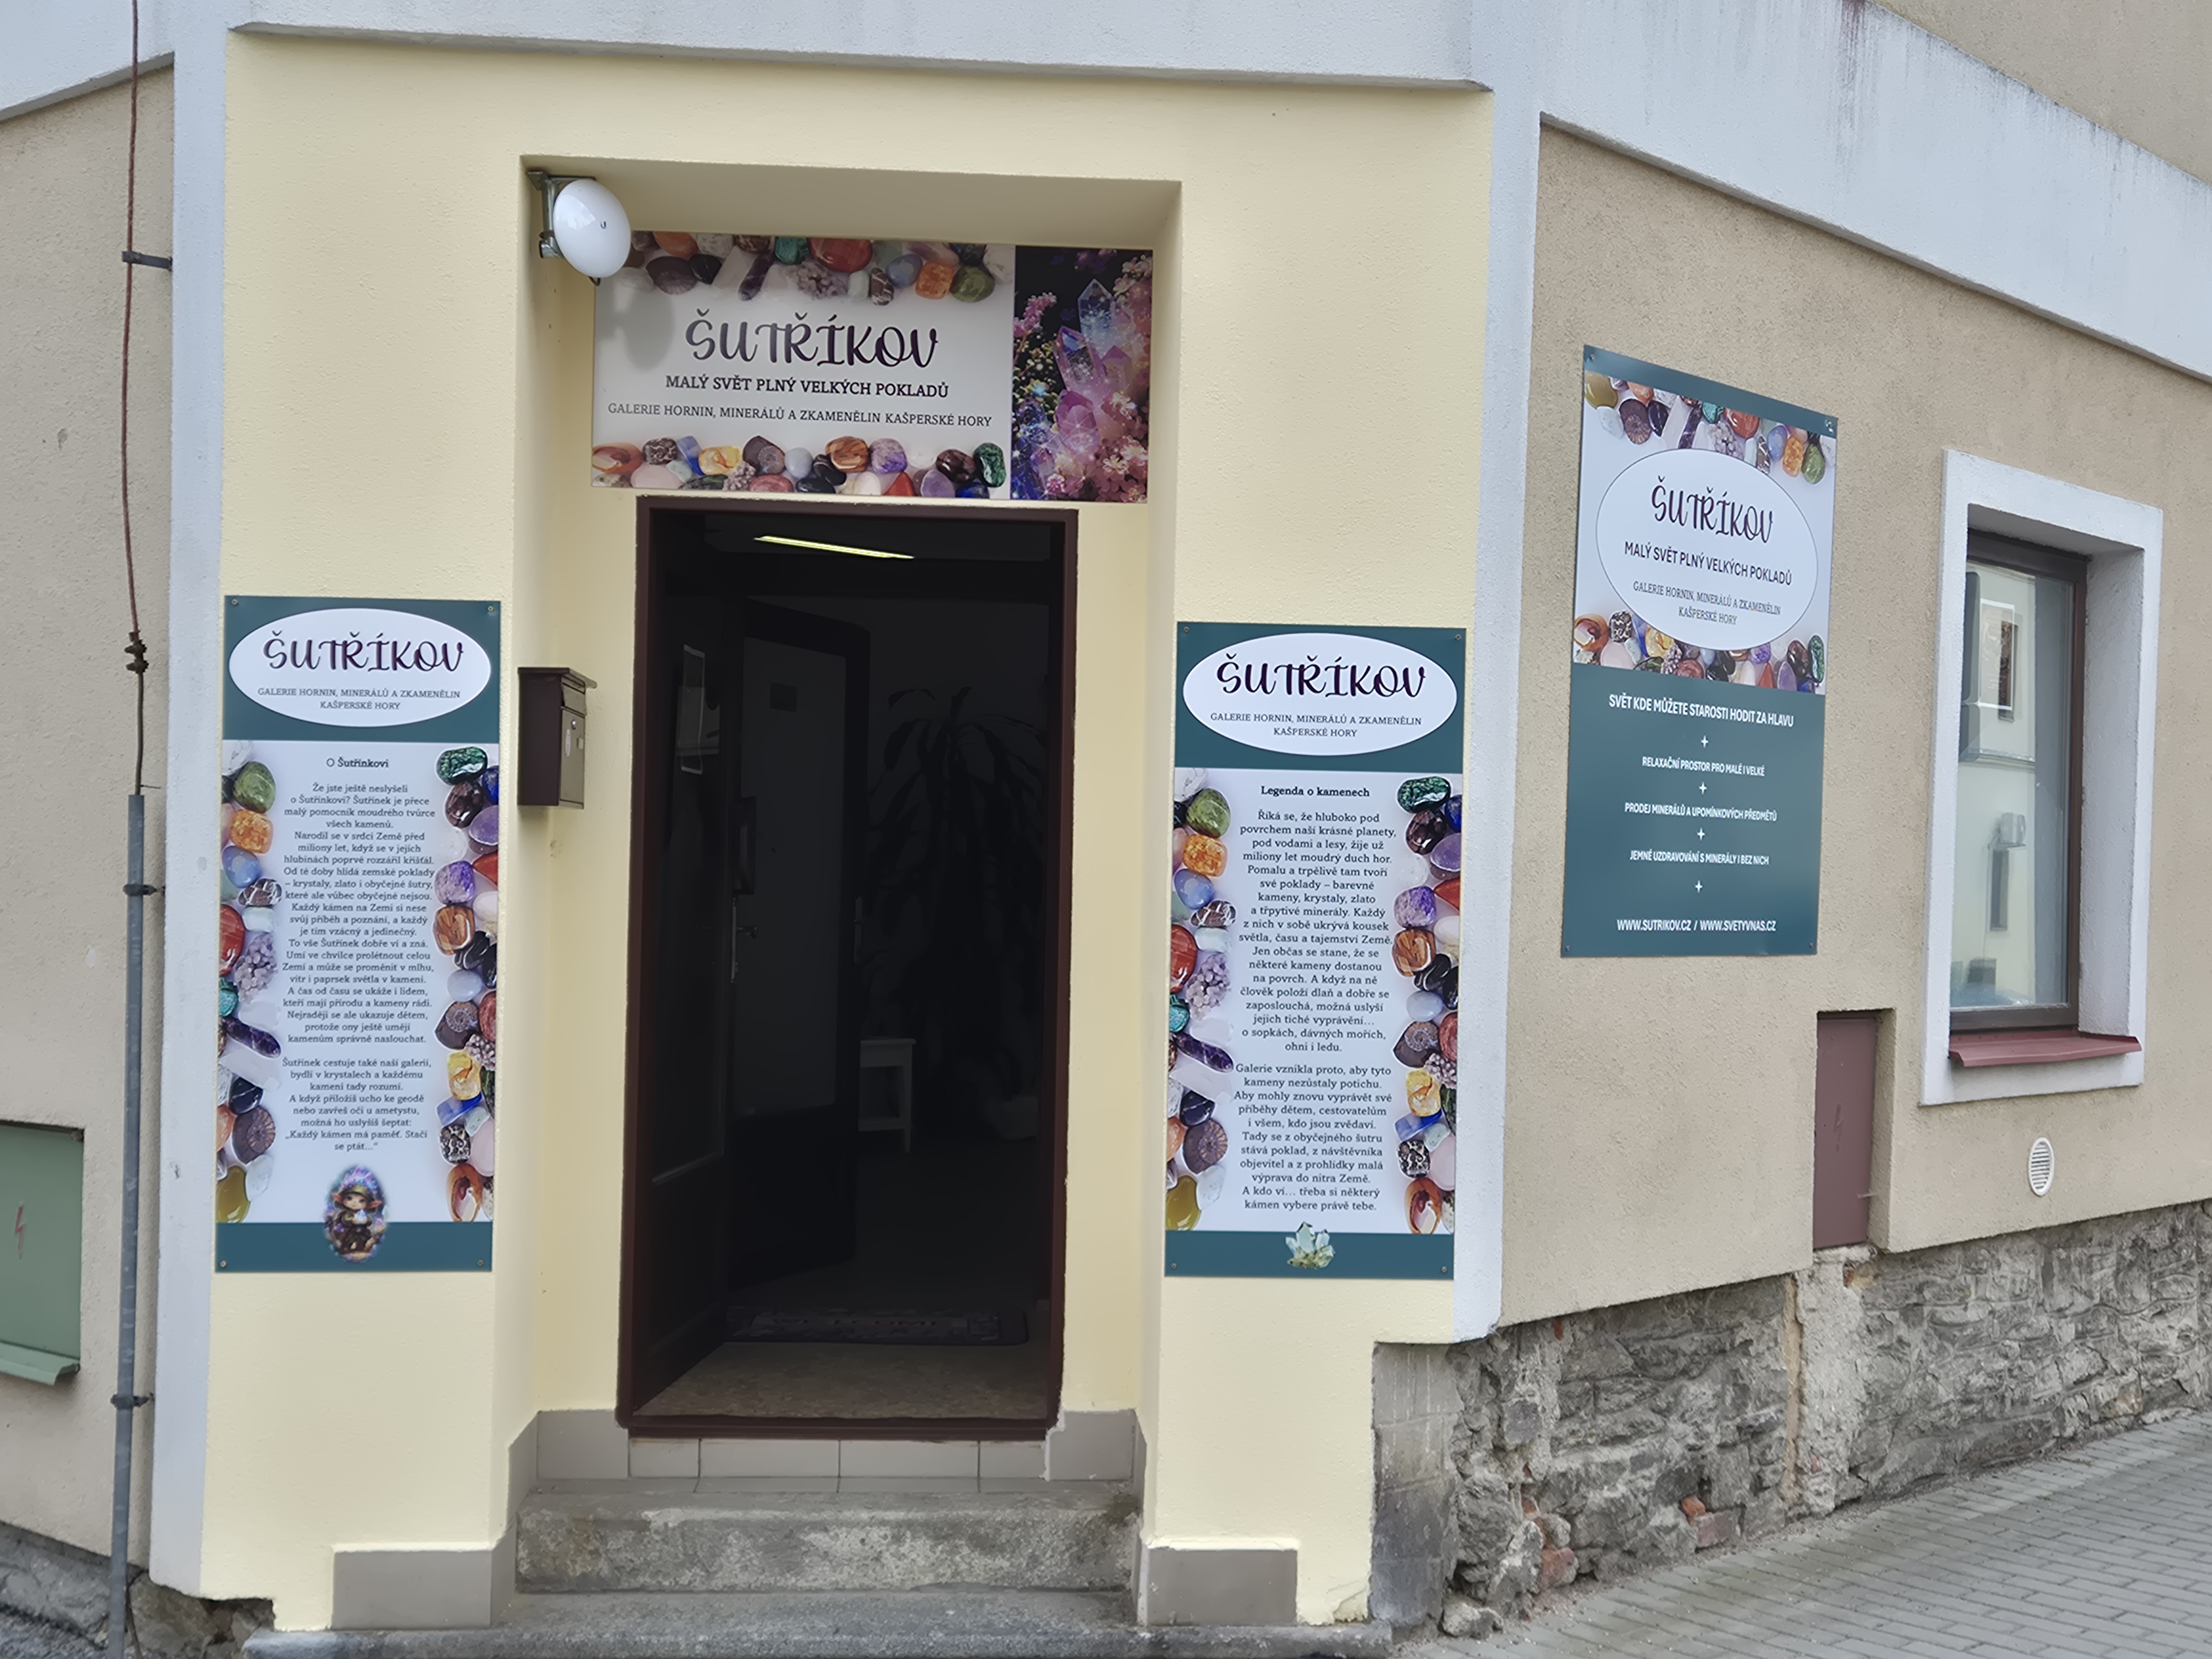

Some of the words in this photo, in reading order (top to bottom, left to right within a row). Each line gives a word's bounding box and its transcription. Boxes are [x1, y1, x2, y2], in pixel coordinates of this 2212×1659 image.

[686, 309, 938, 368] ŠUTŘÍKOV
[666, 373, 709, 388] MALÝ
[713, 374, 752, 390] SVĚT
[756, 377, 796, 392] PLNÝ
[800, 378, 870, 395] VELKÝCH
[875, 381, 948, 398] POKLADŮ
[608, 403, 660, 414] GALERIE
[664, 405, 716, 418] HORNIN,
[720, 406, 784, 419] MINERÁLŮ
[787, 410, 796, 420] A
[800, 410, 880, 422] ZKAMENĚLIN
[885, 411, 954, 425] KAŠPERSKÉ
[957, 415, 992, 426] HORY
[1652, 476, 1773, 543] ŠUTŘÍKOV
[1625, 541, 1652, 558] MALÝ
[1653, 546, 1678, 564] SVĚT
[1679, 551, 1704, 568] PLNÝ
[1706, 556, 1747, 577] VELKÝCH
[1750, 565, 1791, 585] POKLADŮ
[1633, 581, 1664, 595] GALERIE
[1665, 586, 1694, 602] HORNIN,
[1696, 591, 1731, 607] MINERÁLŮ
[1733, 598, 1738, 608] A
[1739, 599, 1780, 614] ZKAMENĚLIN
[1678, 606, 1717, 622] KAŠPERSKÉ
[1718, 613, 1737, 625] HORY
[263, 630, 463, 671] ŠUTŘÍKOV
[1217, 653, 1425, 697] ŠUTŘÍKOV
[299, 688, 338, 697] HORNIN,
[340, 687, 389, 697] MINERÁLŮ
[400, 689, 460, 698] ZKAMENĚLIN
[320, 700, 372, 709] KAŠPERSKÉ
[1609, 692, 1632, 708] SVĚT
[1633, 697, 1652, 711] KDE
[1653, 697, 1688, 716] MŮŽETE
[1689, 703, 1728, 719] STAROSTI
[1729, 708, 1755, 722] HODIT
[1756, 711, 1767, 724] ZA
[1767, 713, 1793, 727] HLAVU
[1210, 712, 1250, 721] GALERIE
[1254, 713, 1293, 723] HORNIN,
[1296, 713, 1347, 724] MINERÁLŮ
[1358, 716, 1421, 725] ZKAMENĚLIN
[1274, 726, 1327, 736] KAŠPERSKÉ
[1330, 728, 1357, 737] HORY
[326, 758, 335, 767] O
[337, 757, 388, 768] Šutřínkovi
[1642, 756, 1680, 769] RELAXAČNÍ
[1680, 759, 1710, 771] PROSTOR
[1710, 762, 1725, 773] PRO
[1725, 763, 1742, 774] MALÉ
[1745, 765, 1764, 776] VELKÉ
[312, 781, 324, 791] Že
[326, 784, 342, 794] jste
[343, 784, 366, 794] ještě
[368, 784, 408, 794] neslyšeli
[1261, 785, 1304, 797] Legenda
[1316, 786, 1370, 796] kamenech
[284, 807, 306, 817] malý
[309, 807, 354, 817] pomocník
[357, 808, 404, 816] moudrého
[406, 808, 435, 817] tvůrce
[1258, 808, 1280, 820] Říká
[1284, 813, 1297, 822] se,
[1300, 812, 1312, 821] že
[1315, 812, 1357, 822] hluboko
[1359, 813, 1379, 824] pod
[1624, 802, 1651, 813] PRODEJ
[1651, 803, 1686, 816] MINERÁLŮ
[1686, 806, 1691, 816] A
[1692, 806, 1743, 819] UPOMÍNKOVÝCH
[1744, 808, 1777, 821] PŘEDMĚTŮ
[326, 820, 352, 828] všech
[354, 820, 393, 828] kamenů.
[1240, 825, 1291, 835] povrchem
[1295, 826, 1315, 834] naší
[1318, 825, 1353, 835] krásné
[1356, 826, 1396, 838] planety,
[1243, 851, 1281, 863] miliony
[1285, 852, 1297, 861] let
[1300, 853, 1341, 864] moudrý
[1344, 853, 1369, 863] duch
[1373, 854, 1391, 863] hor.
[1629, 849, 1652, 860] JEMNÉ
[1652, 850, 1699, 862] UZDRAVOVÁNÍ
[1699, 853, 1704, 863] S
[1705, 852, 1736, 864] MINERÁLY
[1740, 854, 1752, 864] BEZ
[1752, 855, 1769, 865] NICH
[283, 867, 297, 875] Od
[311, 867, 334, 877] doby
[336, 867, 359, 875] hlídá
[362, 868, 395, 876] zemské
[398, 868, 435, 878] poklady
[285, 890, 308, 899] které
[311, 891, 324, 899] ale
[327, 891, 354, 899] vůbec
[357, 891, 397, 901] obyčejné
[400, 891, 432, 902] nejsou.
[1258, 892, 1301, 904] kameny,
[1304, 893, 1347, 905] krystaly,
[1350, 894, 1376, 904] zlato
[1252, 919, 1274, 928] nich
[1286, 920, 1310, 929] sobě
[1313, 920, 1349, 932] ukrývá
[1352, 921, 1389, 930] kousek
[1616, 919, 1691, 931] WWW.SUTRIKOV.CZ
[1693, 920, 1698, 930] /
[1699, 920, 1776, 931] WWW.SVETYVNAS.CZ
[1249, 959, 1287, 969] některé
[1290, 960, 1331, 972] kameny
[1334, 961, 1381, 971] dostanou
[1246, 1000, 1313, 1011] zaposlouchá,
[1316, 1002, 1350, 1011] možná
[1354, 1002, 1383, 1014] uslyší
[287, 1010, 328, 1020] Nejraději
[343, 1010, 356, 1019] ale
[359, 1010, 394, 1021] ukazuje
[397, 1011, 427, 1020] dětem,
[288, 1034, 333, 1042] kamenům
[336, 1035, 372, 1044] správně
[374, 1034, 426, 1042] naslouchat.
[290, 1070, 312, 1080] bydlí
[324, 1070, 371, 1080] krystalech
[382, 1070, 422, 1078] každému
[1235, 1063, 1272, 1073] Galerie
[1275, 1064, 1312, 1073] vznikla
[1316, 1066, 1345, 1076] proto,
[1349, 1065, 1368, 1077] aby
[1371, 1067, 1391, 1077] tyto
[1238, 1104, 1277, 1116] příběhy
[1280, 1104, 1315, 1115] dětem,
[1318, 1106, 1386, 1115] cestovatelům
[1244, 1199, 1279, 1208] kámen
[1282, 1200, 1317, 1212] vybere
[1321, 1201, 1349, 1212] právě
[1352, 1201, 1376, 1210] tebe.
